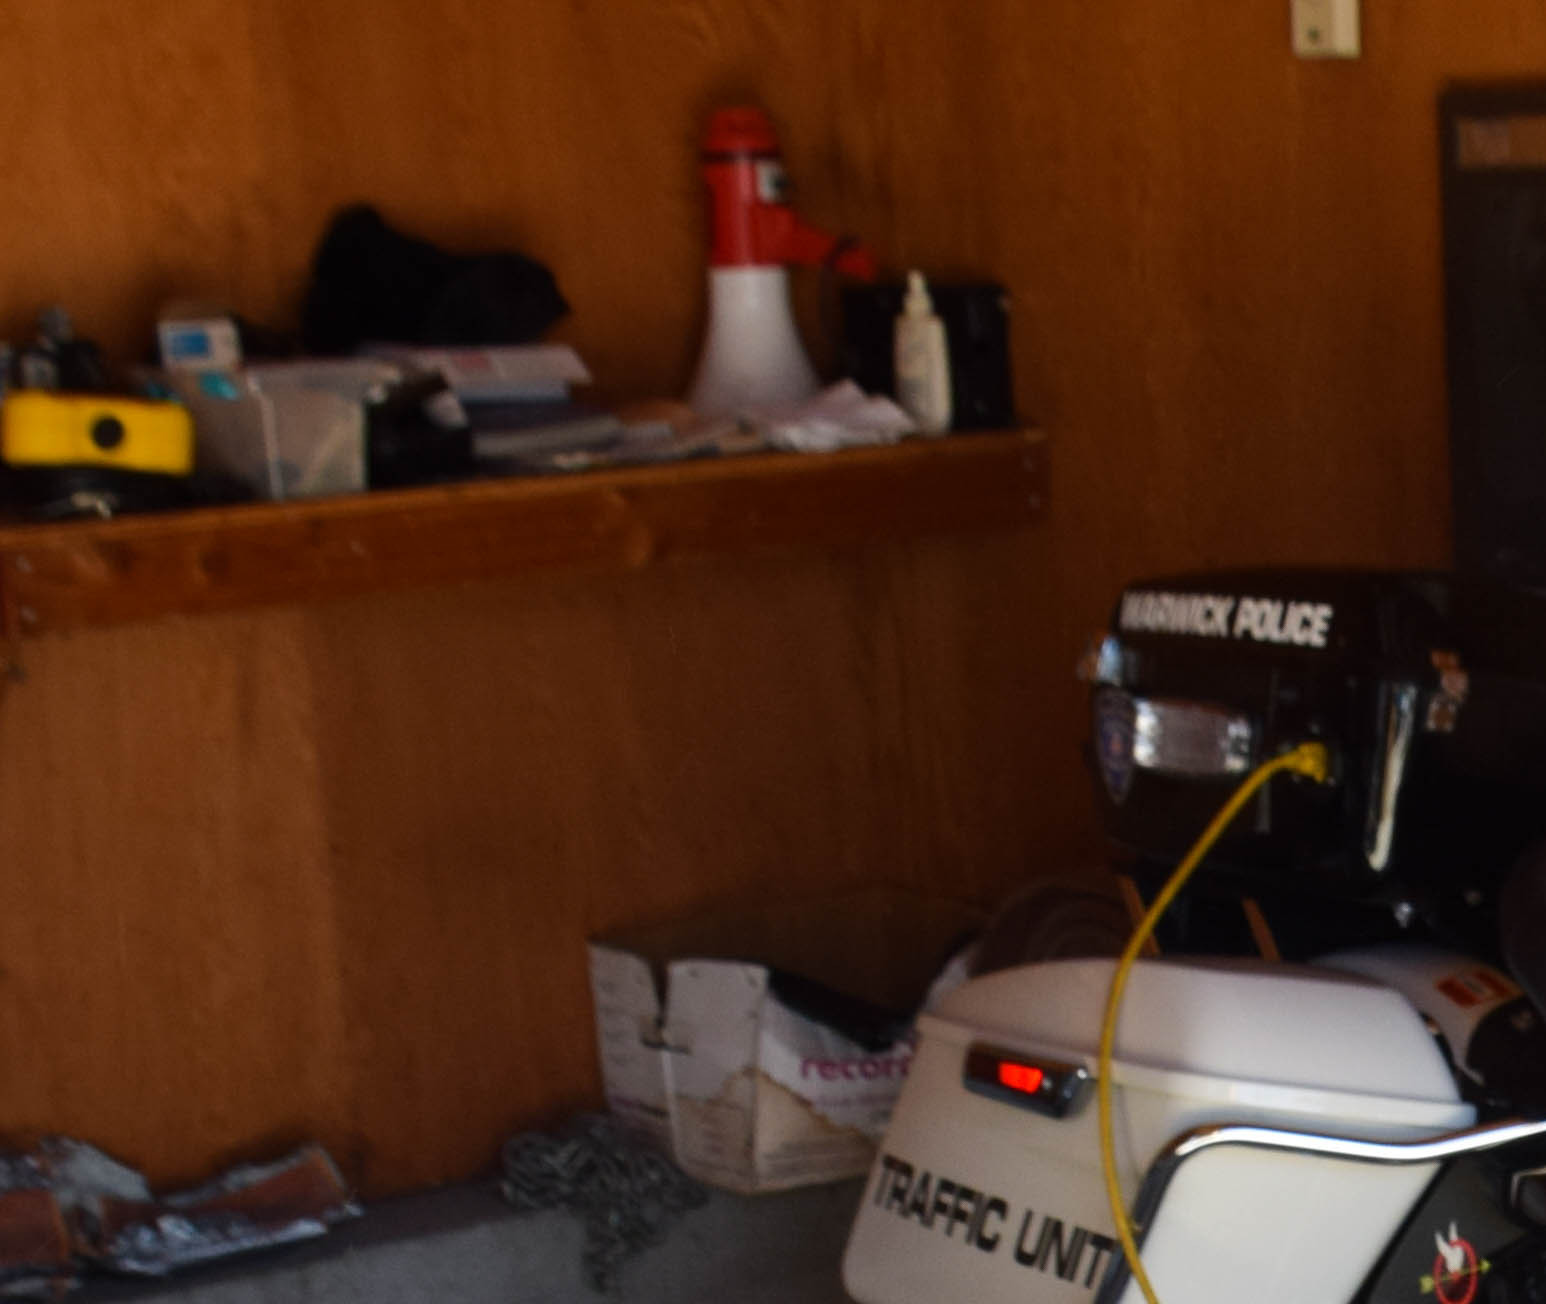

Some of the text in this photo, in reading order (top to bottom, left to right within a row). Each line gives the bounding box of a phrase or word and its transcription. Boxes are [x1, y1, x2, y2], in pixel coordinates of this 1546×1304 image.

[1119, 589, 1335, 648] WARWICK POLICE
[874, 1153, 1119, 1290] TRAFFIC UNIT
